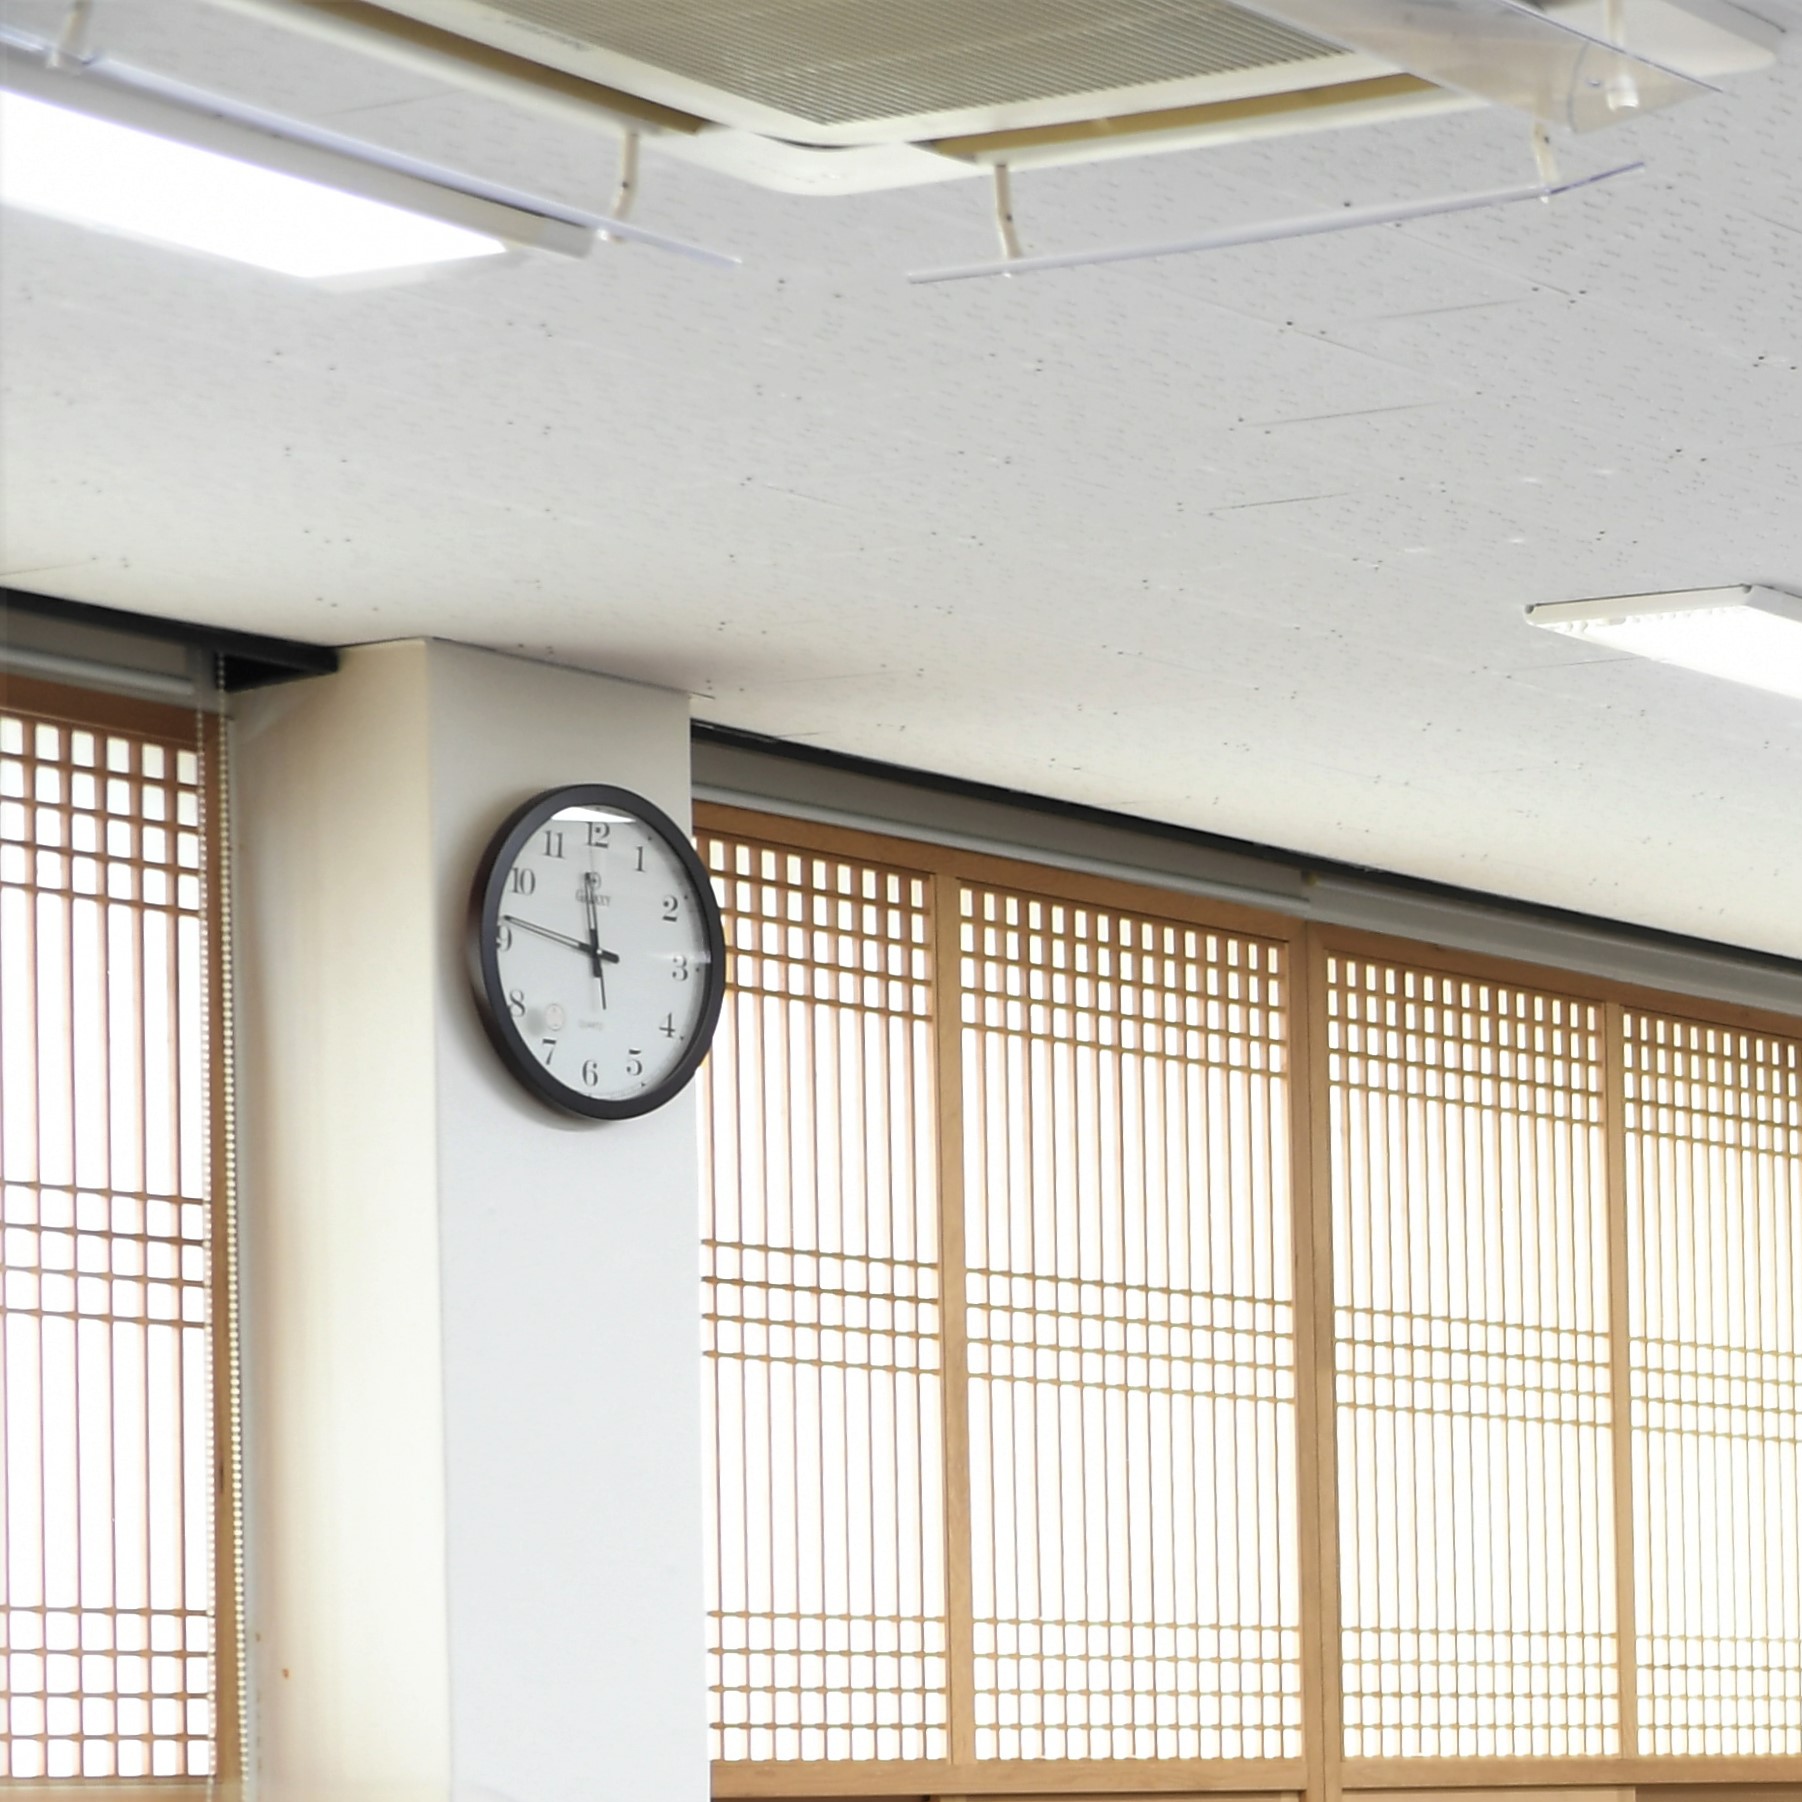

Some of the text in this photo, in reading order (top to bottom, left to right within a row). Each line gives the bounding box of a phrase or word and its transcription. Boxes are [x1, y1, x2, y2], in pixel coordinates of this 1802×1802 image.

[542, 829, 565, 859] 11
[584, 820, 610, 848] 12
[634, 845, 646, 872] 1
[510, 866, 536, 895] 10
[662, 895, 679, 922] 2
[496, 923, 513, 952] 9
[672, 955, 688, 982] 3
[507, 988, 526, 1018] 8
[658, 1012, 676, 1038] 4
[541, 1038, 557, 1066] 7
[626, 1048, 643, 1076] 5
[582, 1059, 599, 1087] 6
